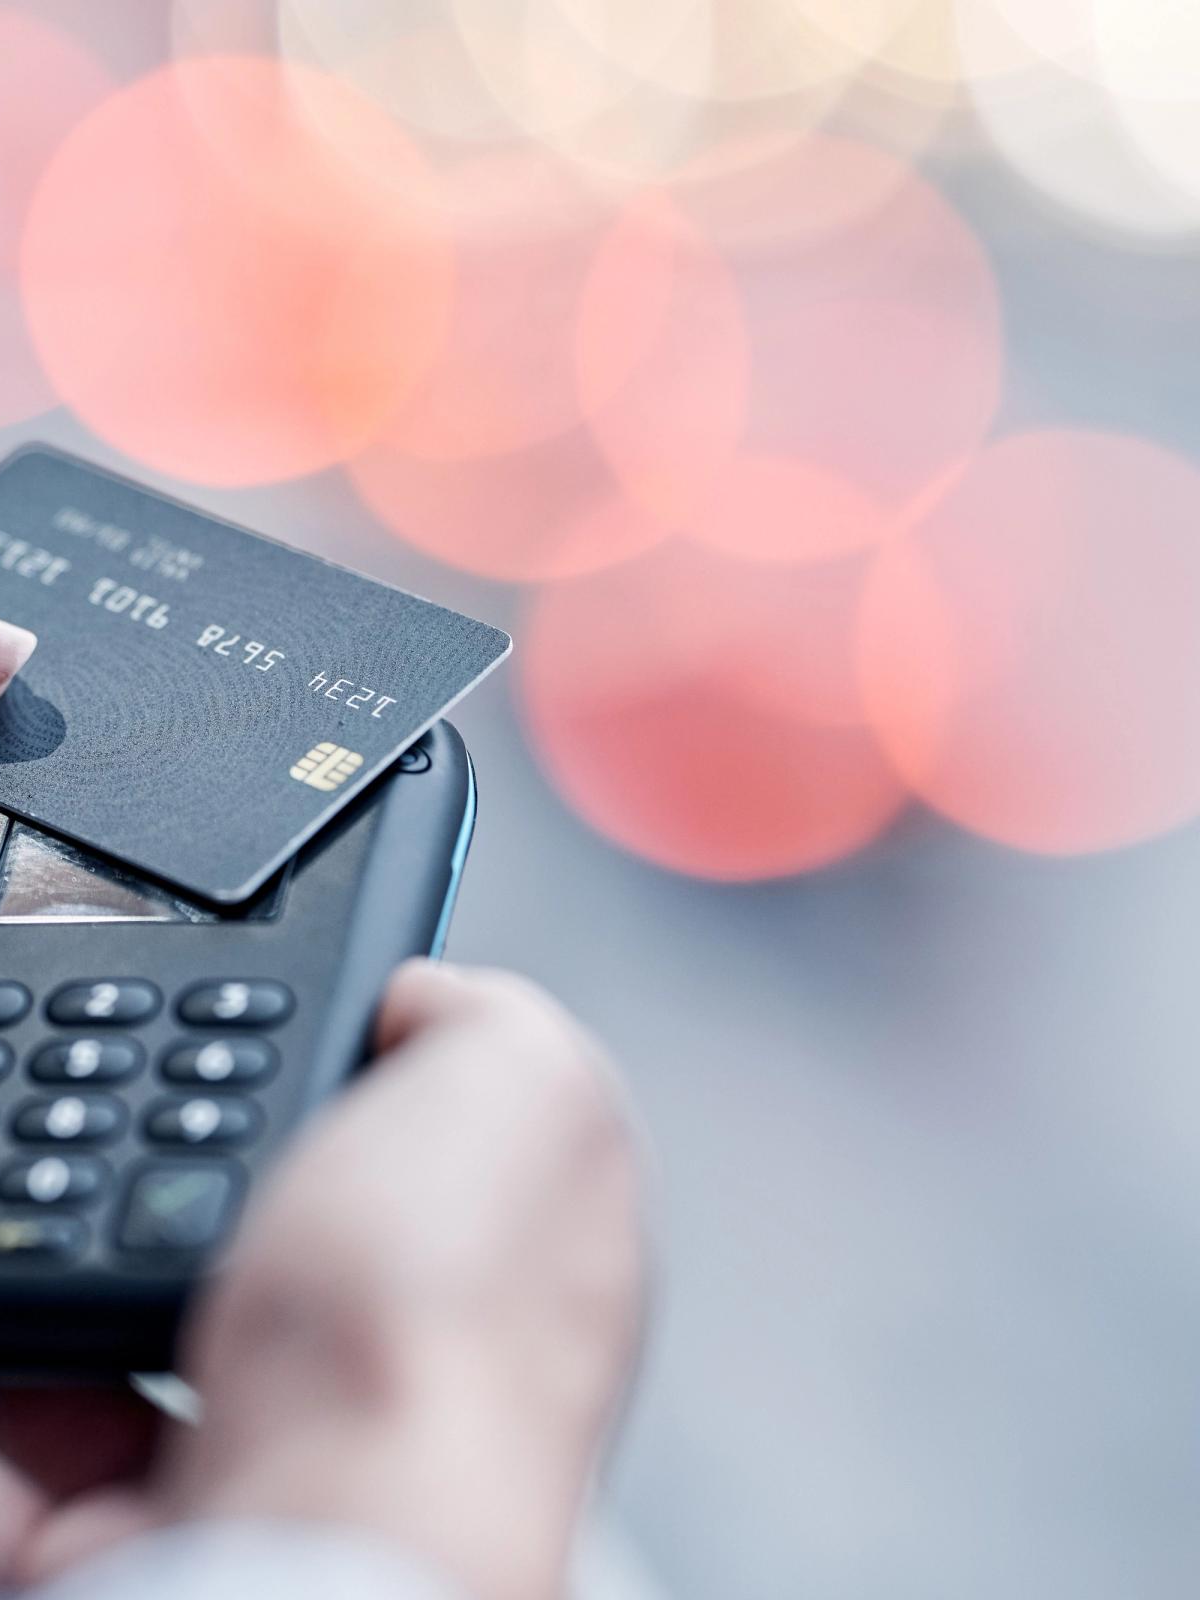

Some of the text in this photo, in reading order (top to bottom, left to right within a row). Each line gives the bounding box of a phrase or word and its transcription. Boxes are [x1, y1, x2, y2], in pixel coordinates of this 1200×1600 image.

[87, 576, 171, 631] 9101
[196, 623, 286, 672] 5678
[308, 670, 398, 719] 1234
[85, 983, 120, 1017] 2
[214, 982, 250, 1018] 3
